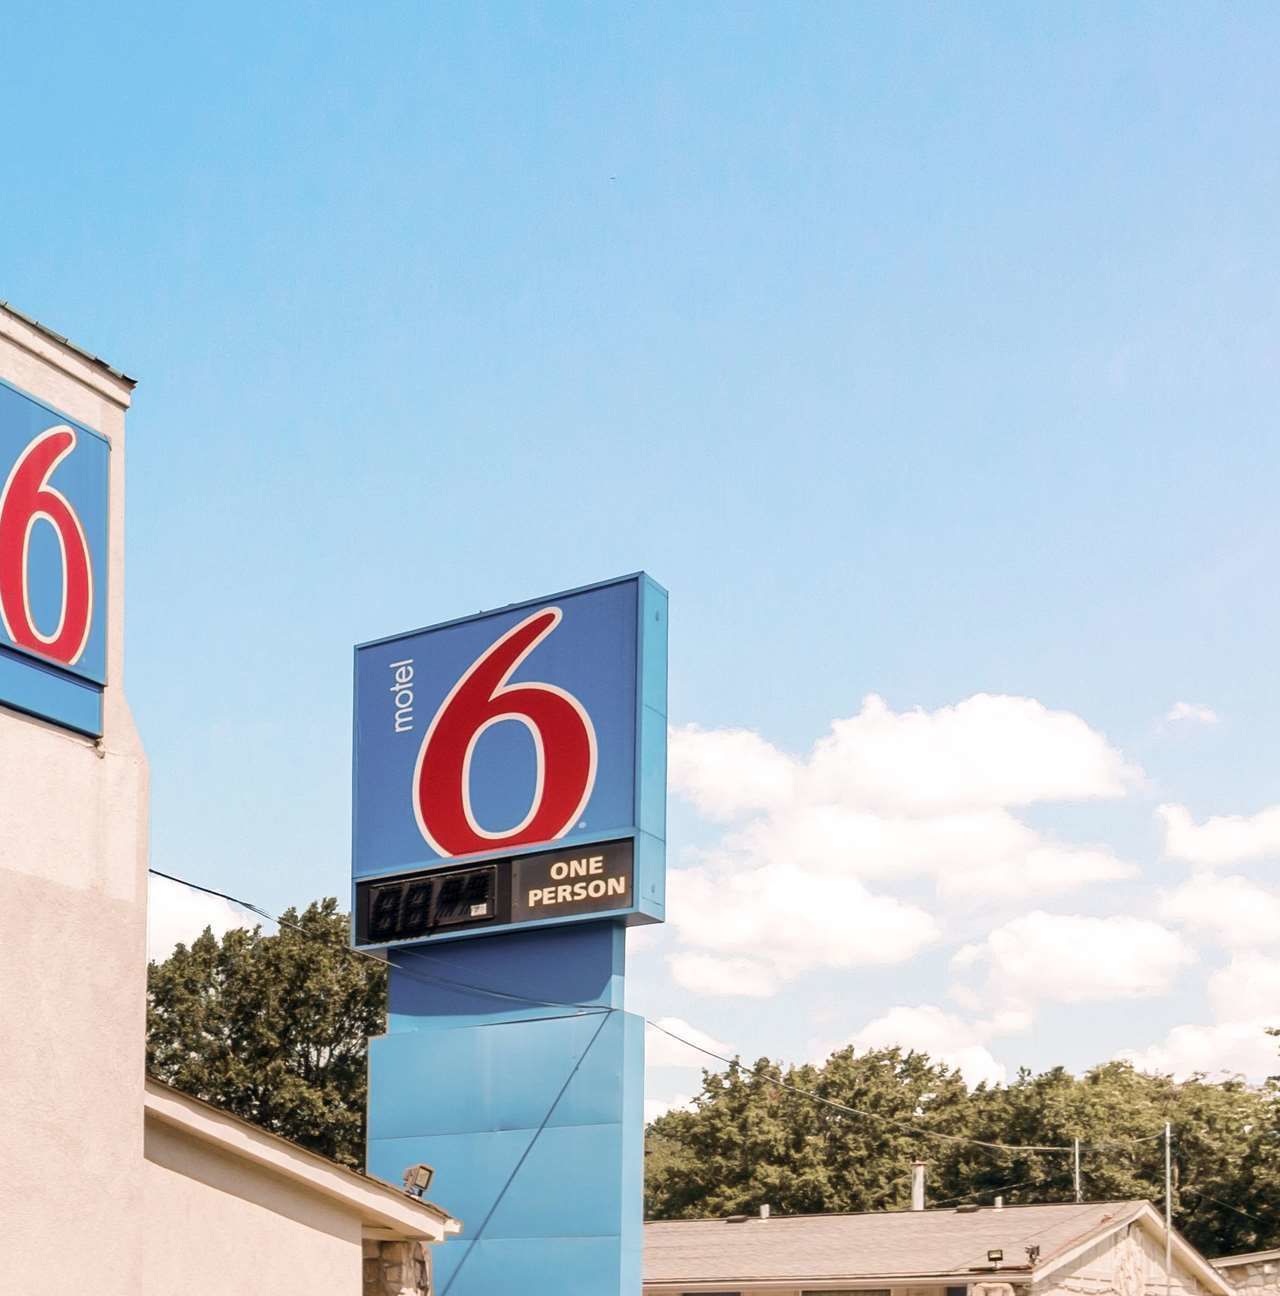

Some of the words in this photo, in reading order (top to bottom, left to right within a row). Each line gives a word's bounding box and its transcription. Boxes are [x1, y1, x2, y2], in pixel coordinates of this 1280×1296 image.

[390, 659, 414, 733] motel
[412, 606, 598, 858] 6
[550, 856, 604, 880] ONE
[528, 876, 625, 907] PERSON
